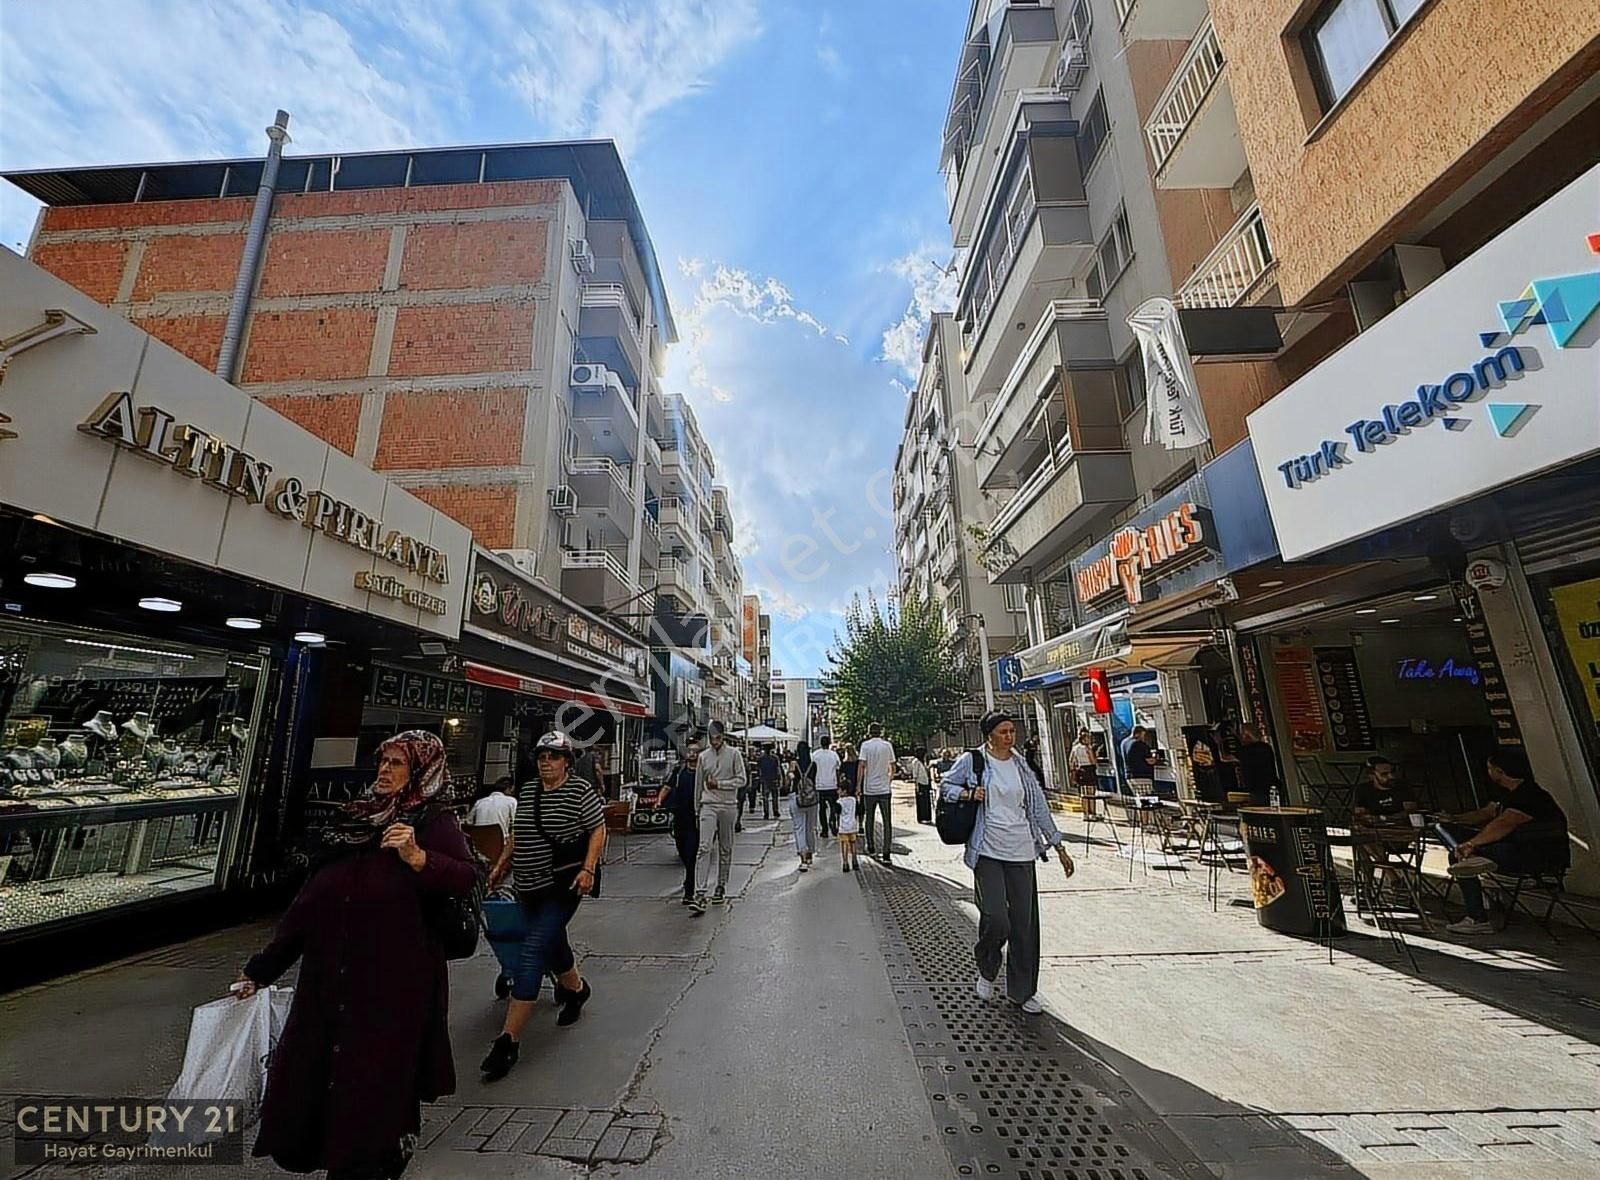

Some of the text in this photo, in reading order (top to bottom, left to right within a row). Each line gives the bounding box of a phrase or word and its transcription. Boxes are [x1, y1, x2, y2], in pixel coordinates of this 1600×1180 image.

[1278, 346, 1526, 489] Türk Telekom
[77, 391, 450, 586] ALTIN & PIRLANTA
[1139, 502, 1203, 570] FRIES
[1398, 659, 1434, 680] Take
